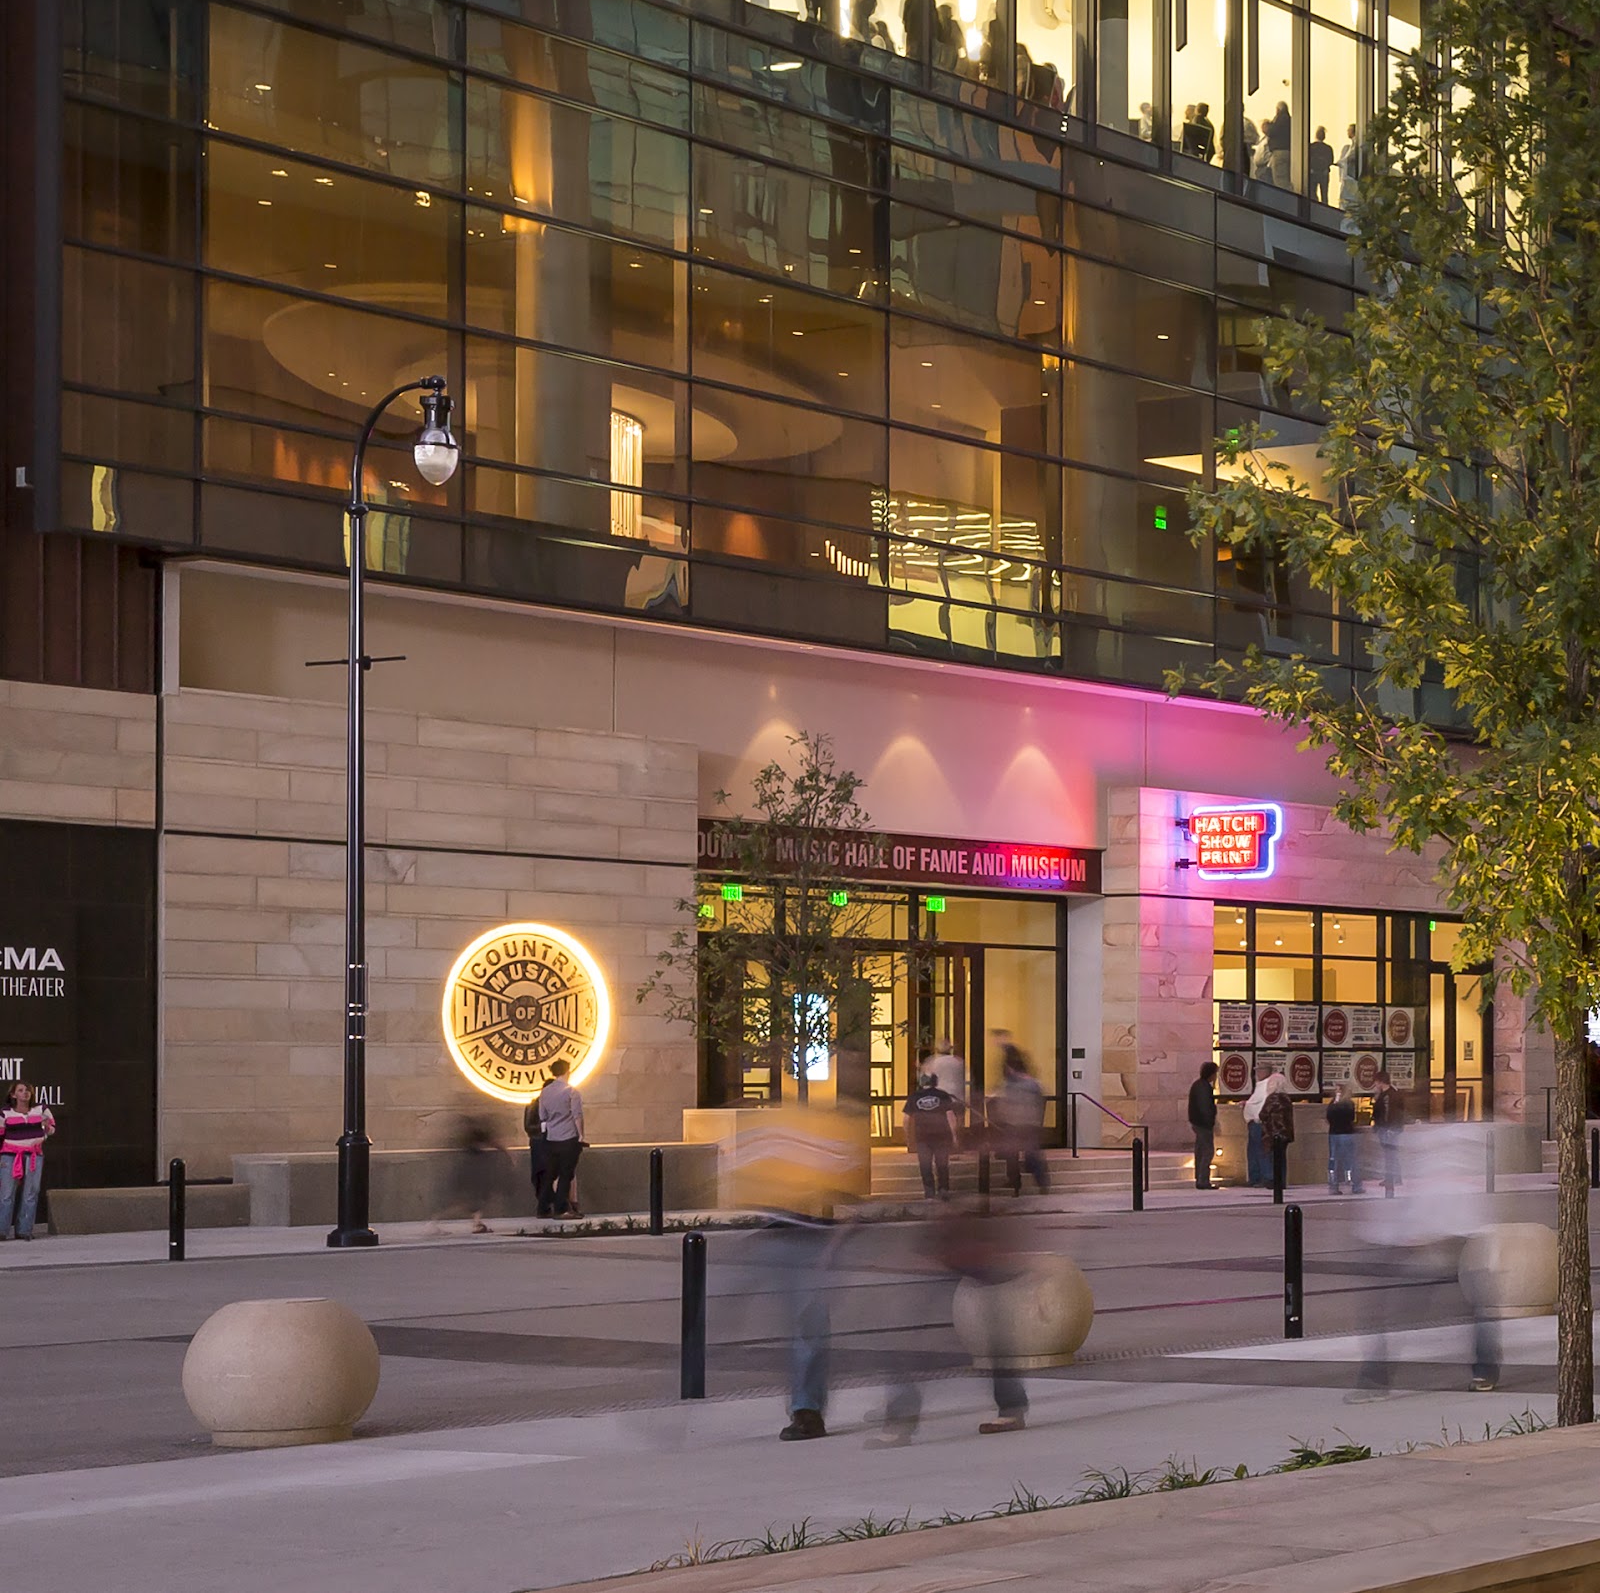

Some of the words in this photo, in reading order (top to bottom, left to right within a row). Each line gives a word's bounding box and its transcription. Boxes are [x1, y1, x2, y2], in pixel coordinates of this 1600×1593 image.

[1195, 815, 1258, 834] HATCH
[1200, 834, 1252, 849] SHOW
[845, 842, 889, 869] HALL
[893, 845, 916, 871] OF
[920, 847, 968, 874] FAME
[972, 851, 1006, 877] AND
[1011, 855, 1086, 882] MUSEUM
[1201, 850, 1252, 864] PRINT
[0, 947, 65, 971] MA
[470, 940, 584, 983] COUNTRY
[0, 976, 65, 997] THEATER
[489, 962, 562, 993] MUSIC
[456, 984, 508, 1038] HALL
[515, 1007, 536, 1020] OF
[489, 1034, 562, 1061] MUSEUM
[510, 1029, 541, 1041] AND
[469, 1044, 580, 1085] NASHVIE
